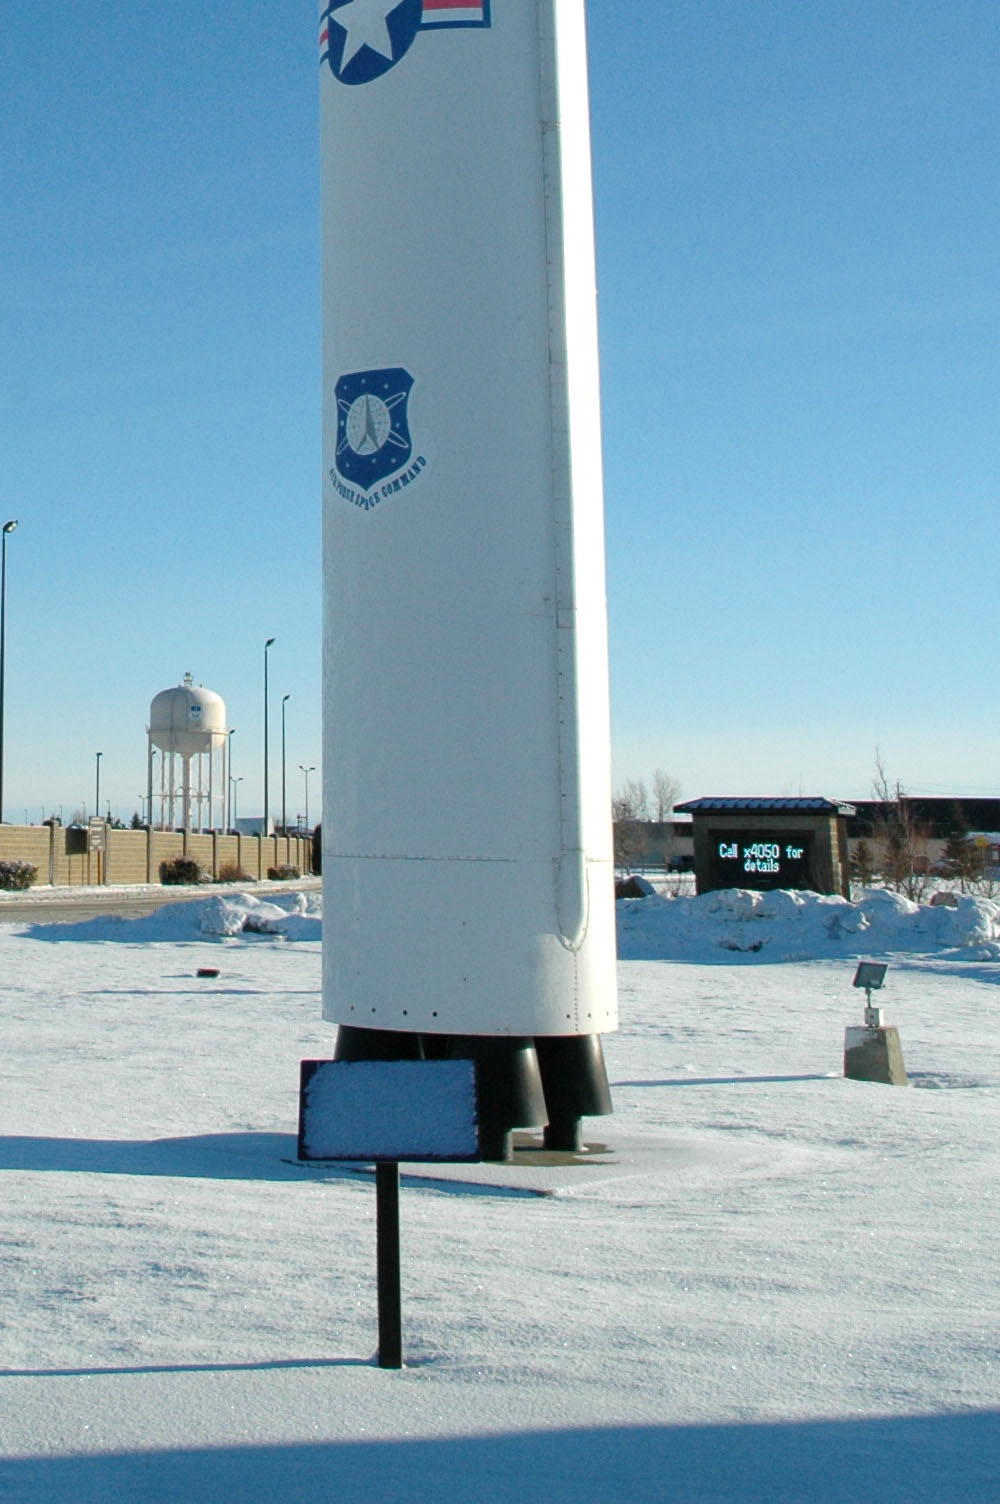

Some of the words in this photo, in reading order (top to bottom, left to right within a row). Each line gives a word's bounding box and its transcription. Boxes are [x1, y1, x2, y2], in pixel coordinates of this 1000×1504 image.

[355, 492, 380, 510] SPACE
[381, 456, 426, 497] COMMAND
[719, 843, 738, 858] Call
[743, 843, 780, 858] x4050
[785, 845, 804, 858] for
[743, 858, 780, 872] details
